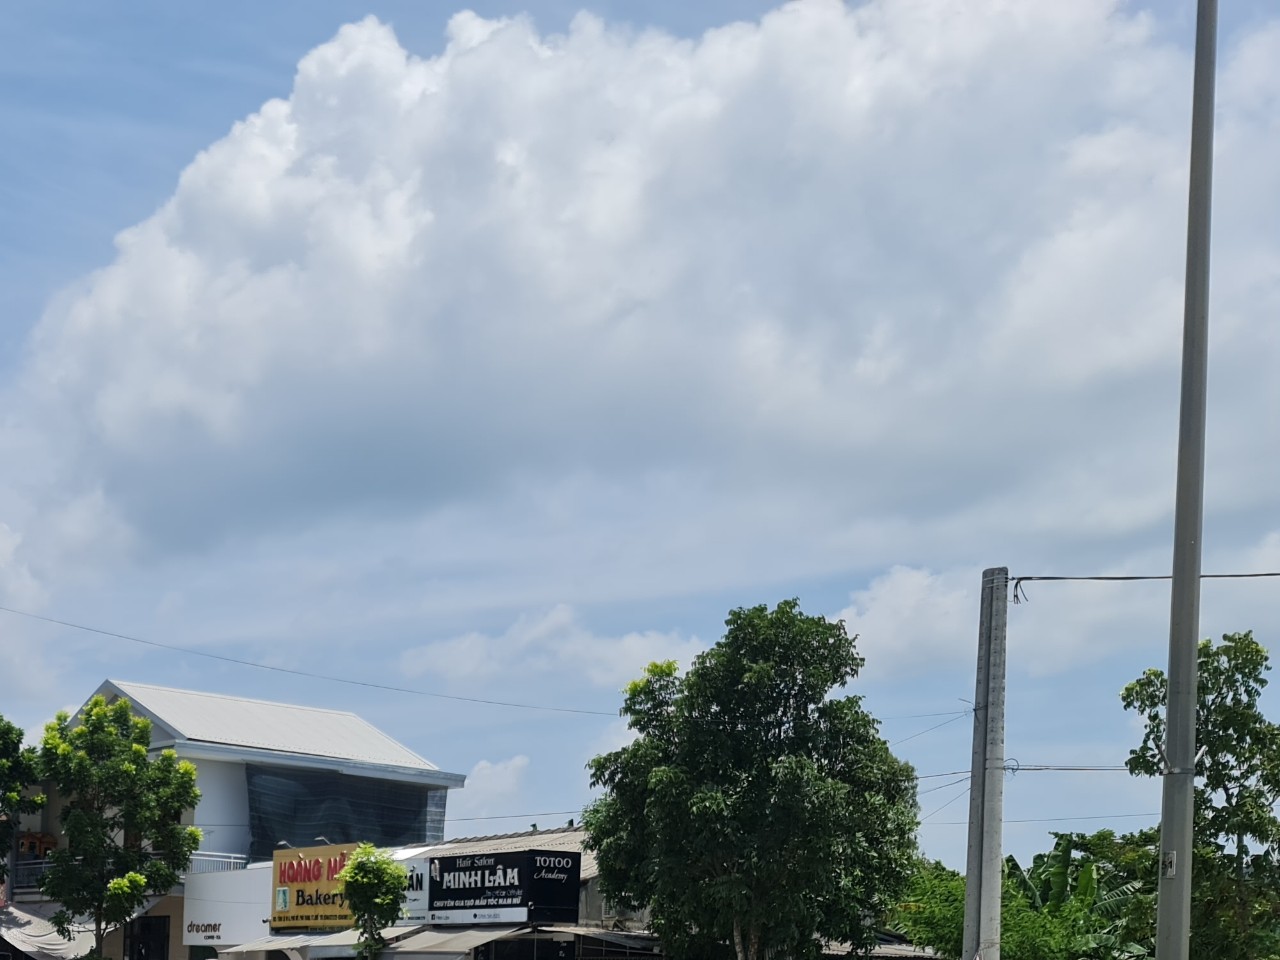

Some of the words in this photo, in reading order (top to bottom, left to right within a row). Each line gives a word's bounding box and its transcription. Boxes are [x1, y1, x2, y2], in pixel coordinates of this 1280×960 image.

[279, 853, 322, 884] HOÀNG
[535, 857, 571, 868] TOTOO
[442, 870, 481, 889] MINH
[484, 865, 519, 887] LÂM
[534, 869, 568, 883] Academy
[295, 889, 345, 909] Bakery
[187, 920, 221, 933] dreamer
